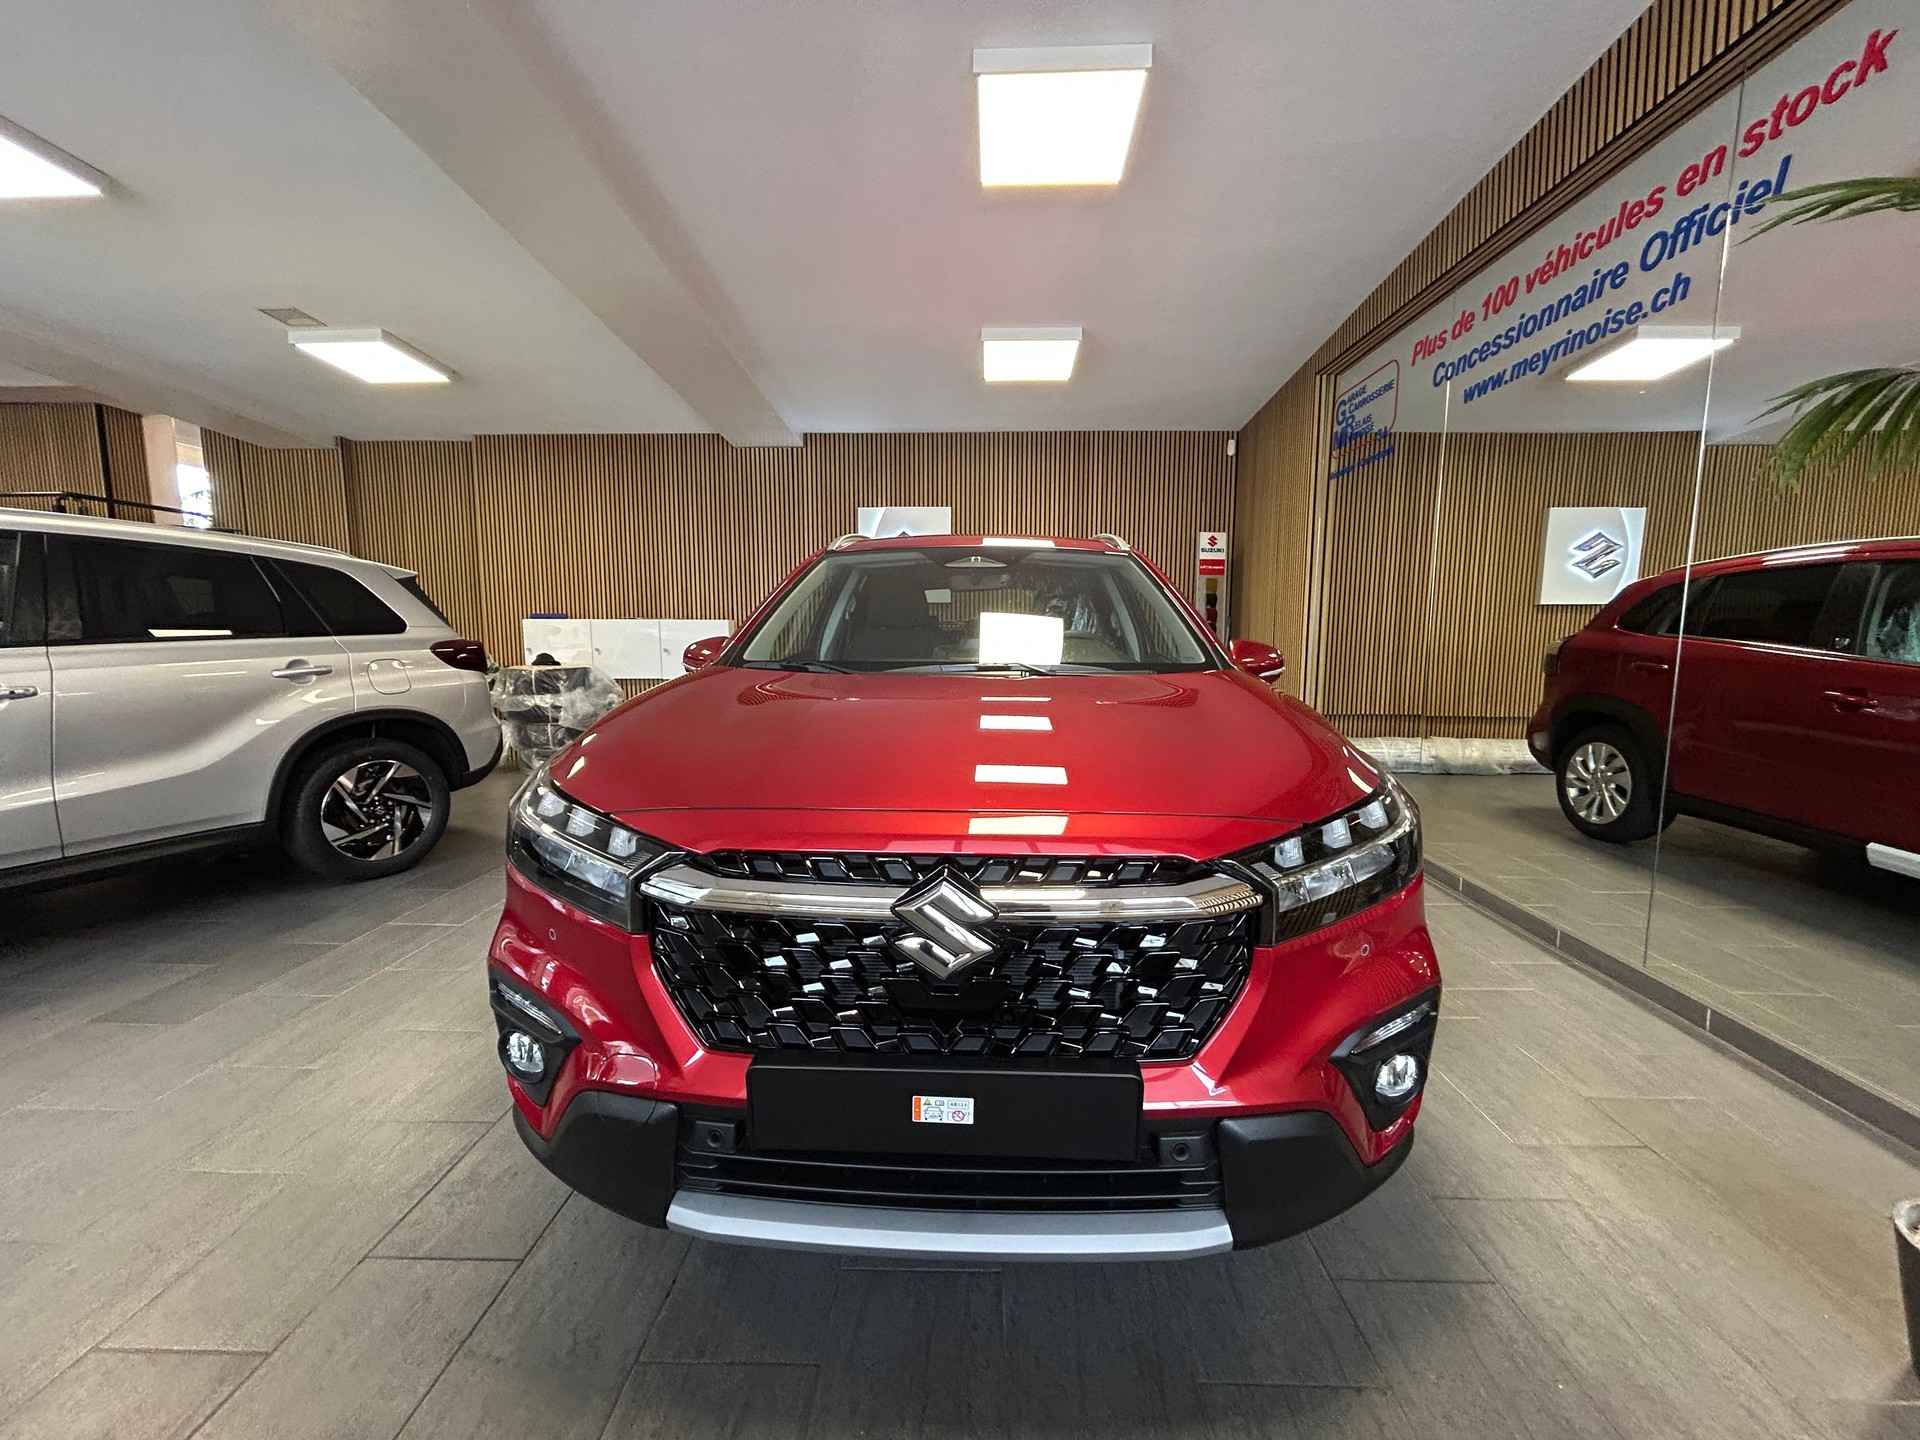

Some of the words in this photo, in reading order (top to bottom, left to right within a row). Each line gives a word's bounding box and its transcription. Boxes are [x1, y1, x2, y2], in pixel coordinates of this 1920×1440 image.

[1411, 329, 1448, 367] Plus
[1451, 310, 1476, 340] de
[1482, 276, 1519, 321] 100
[1525, 186, 1667, 294] véhicules
[1676, 145, 1727, 196] en
[1738, 28, 1898, 158] stock
[1432, 261, 1629, 388] Concessionnaire
[1640, 154, 1792, 272] Officiel
[1463, 272, 1691, 404] www.meyrinoise.ch
